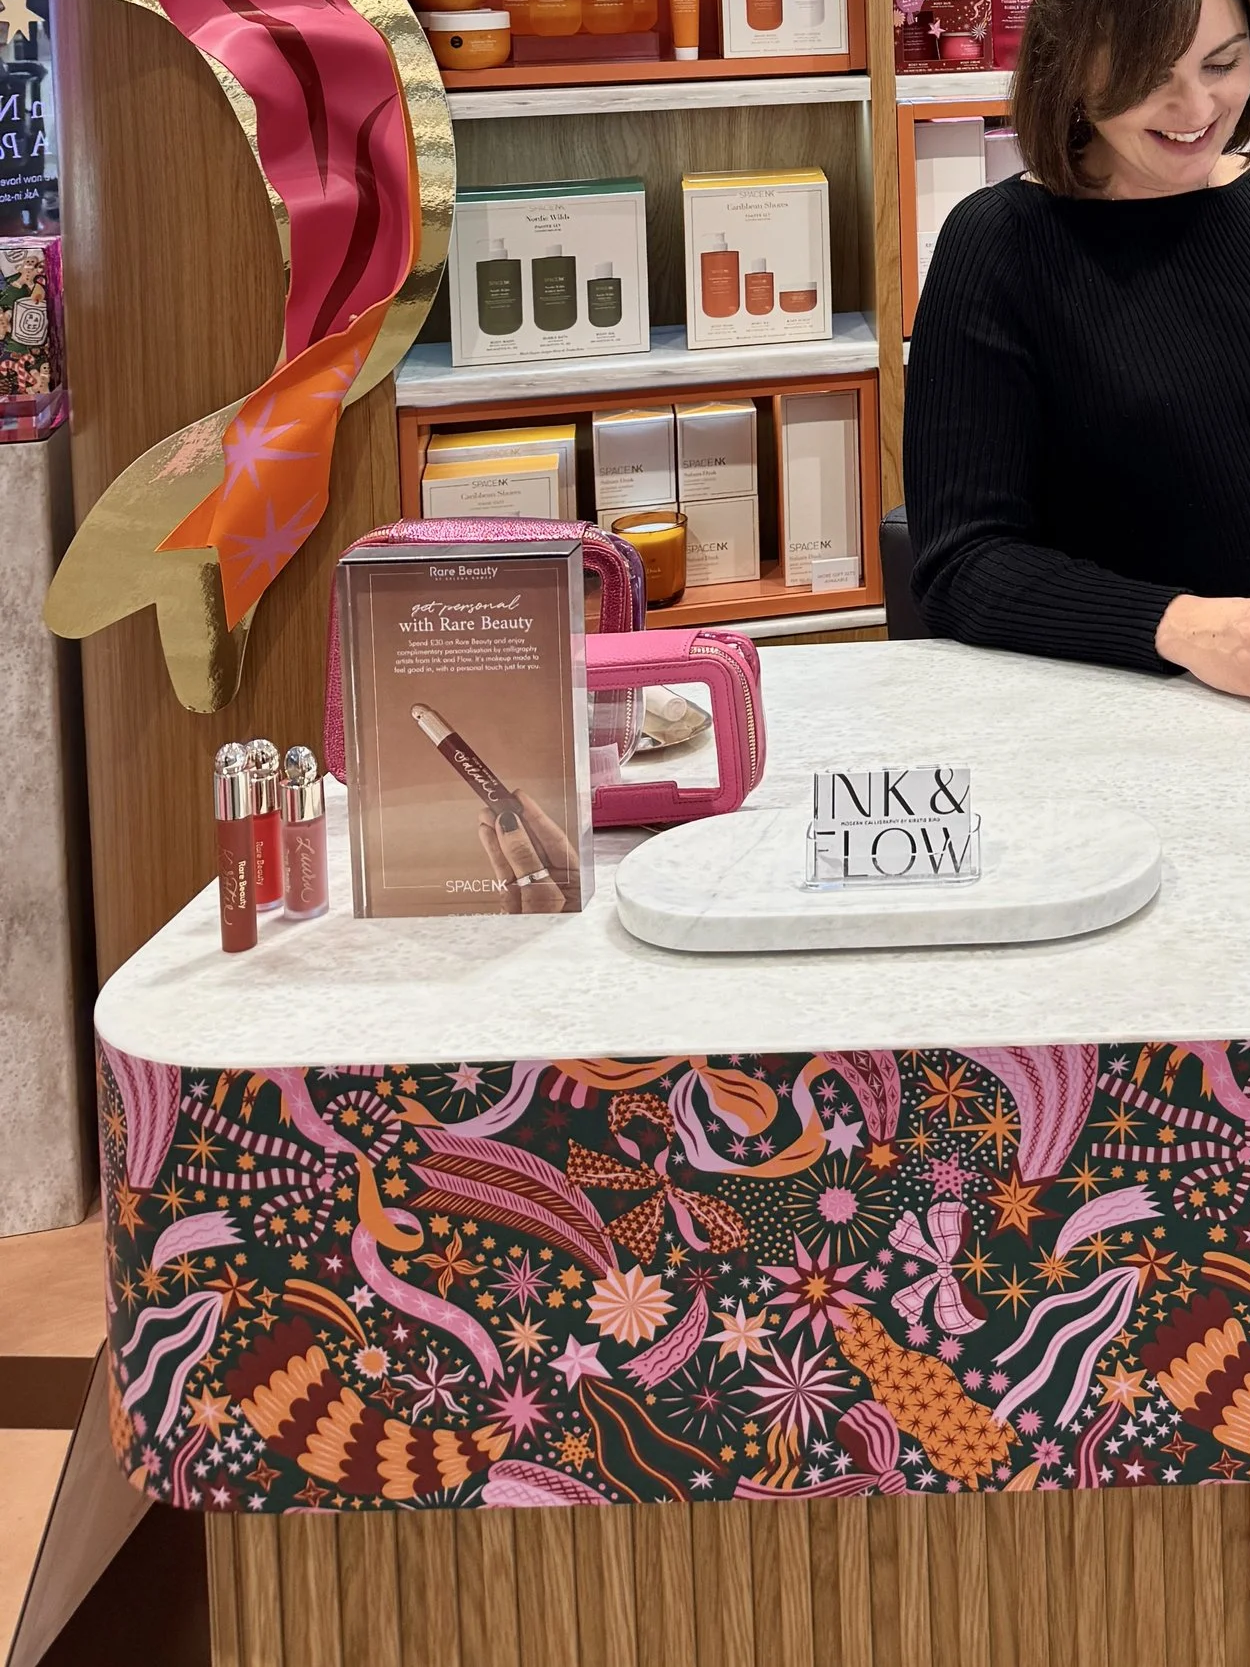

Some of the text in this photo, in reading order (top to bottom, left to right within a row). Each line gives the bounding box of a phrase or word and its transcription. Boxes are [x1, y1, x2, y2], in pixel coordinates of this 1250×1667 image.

[472, 478, 509, 489] SPACENK
[789, 539, 832, 553] SPACENK
[429, 565, 498, 578] Rare Beauty
[411, 594, 521, 618] get personal
[399, 615, 534, 633] with Rare Beauty
[408, 639, 428, 647] Spend
[430, 638, 444, 646] £30
[455, 638, 470, 646] Rare
[471, 637, 492, 646] Beauty
[493, 637, 506, 645] and
[507, 637, 525, 646] enjoy
[396, 645, 538, 657] complimentary personalisation by calligraphy
[395, 657, 414, 666] artists
[414, 656, 431, 664] from
[431, 656, 441, 664] Ink
[442, 655, 456, 664] and
[485, 654, 511, 663] makeup
[512, 654, 531, 662] made
[394, 666, 406, 674] feel
[407, 665, 425, 675] good
[435, 665, 449, 673] with
[456, 664, 484, 673] personal
[484, 663, 503, 671] touch
[503, 662, 516, 672] just
[516, 662, 526, 670] for
[814, 768, 970, 819] INK &
[814, 827, 971, 878] FLOW
[256, 841, 264, 886] Rare Beauty
[238, 860, 248, 909] Rare Beauty
[446, 879, 509, 893] SPACENK
